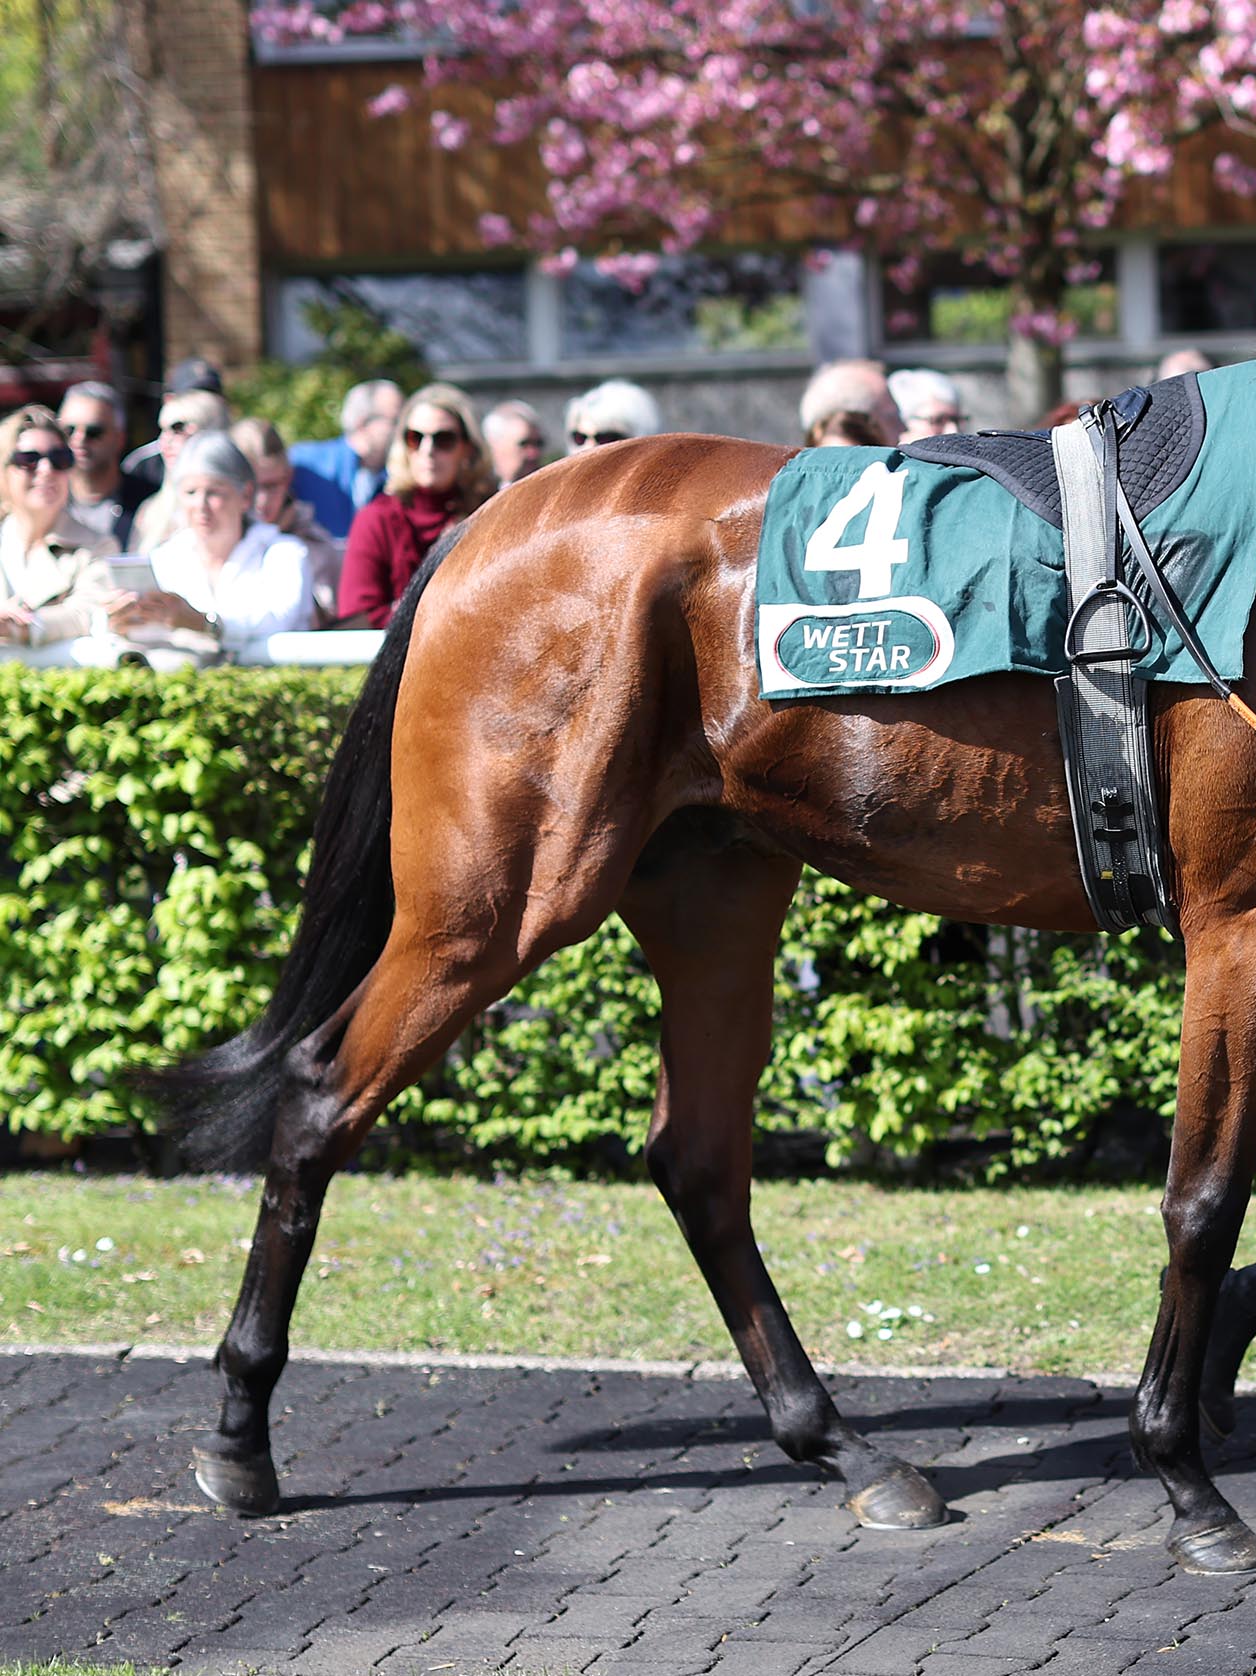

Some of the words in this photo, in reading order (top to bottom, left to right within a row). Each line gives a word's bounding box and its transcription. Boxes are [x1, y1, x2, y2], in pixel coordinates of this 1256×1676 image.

[803, 461, 909, 599] 4
[803, 620, 892, 648] WETT
[829, 645, 910, 673] STAR
